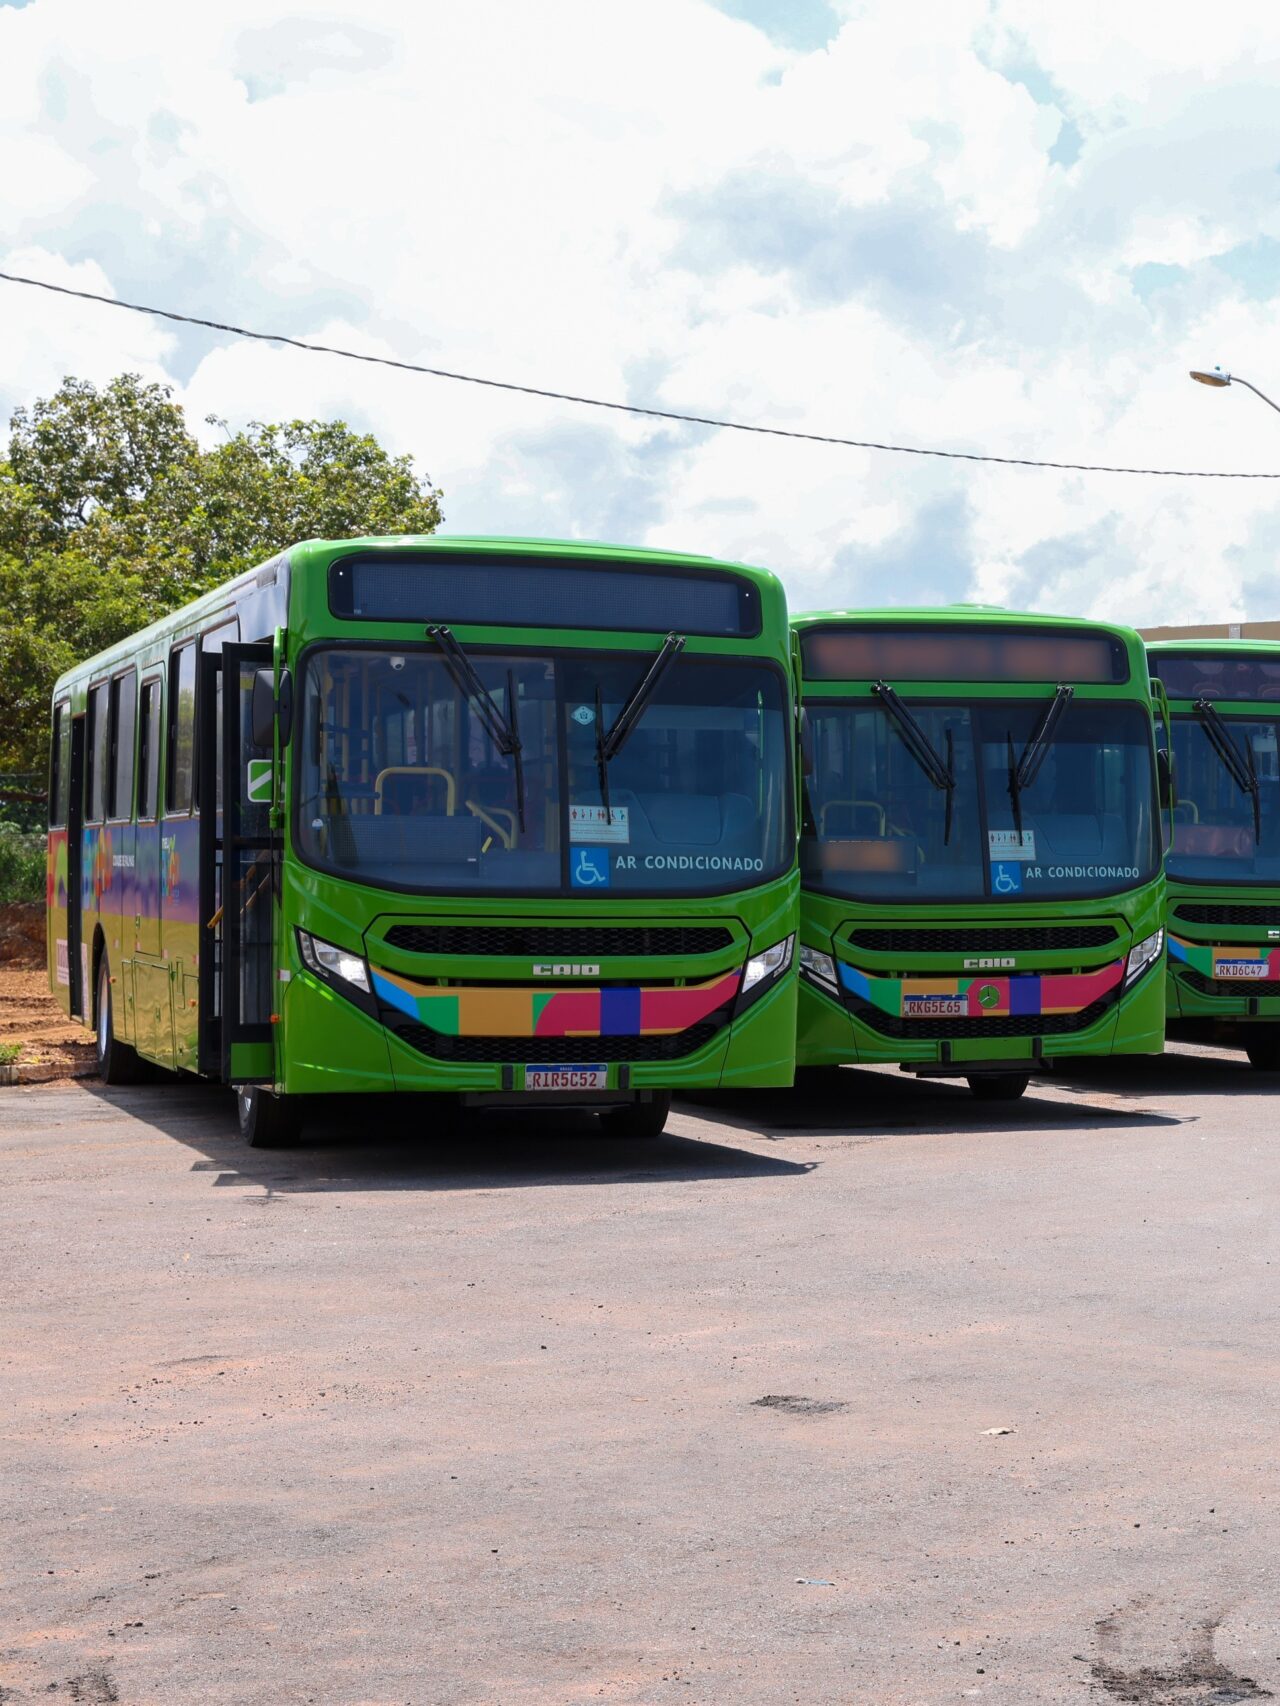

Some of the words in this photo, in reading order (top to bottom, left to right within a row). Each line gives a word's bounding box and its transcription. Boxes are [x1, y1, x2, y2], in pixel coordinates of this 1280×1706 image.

[615, 855, 637, 869] AR
[644, 855, 764, 872] CONDICIONADO
[1025, 866, 1042, 879] AR
[1047, 866, 1140, 879] CONDICIONADO
[532, 964, 600, 976] CAIO
[963, 958, 1016, 969] CAIO
[908, 1001, 961, 1014] RKG5E65
[532, 1072, 598, 1088] RIR5C52
